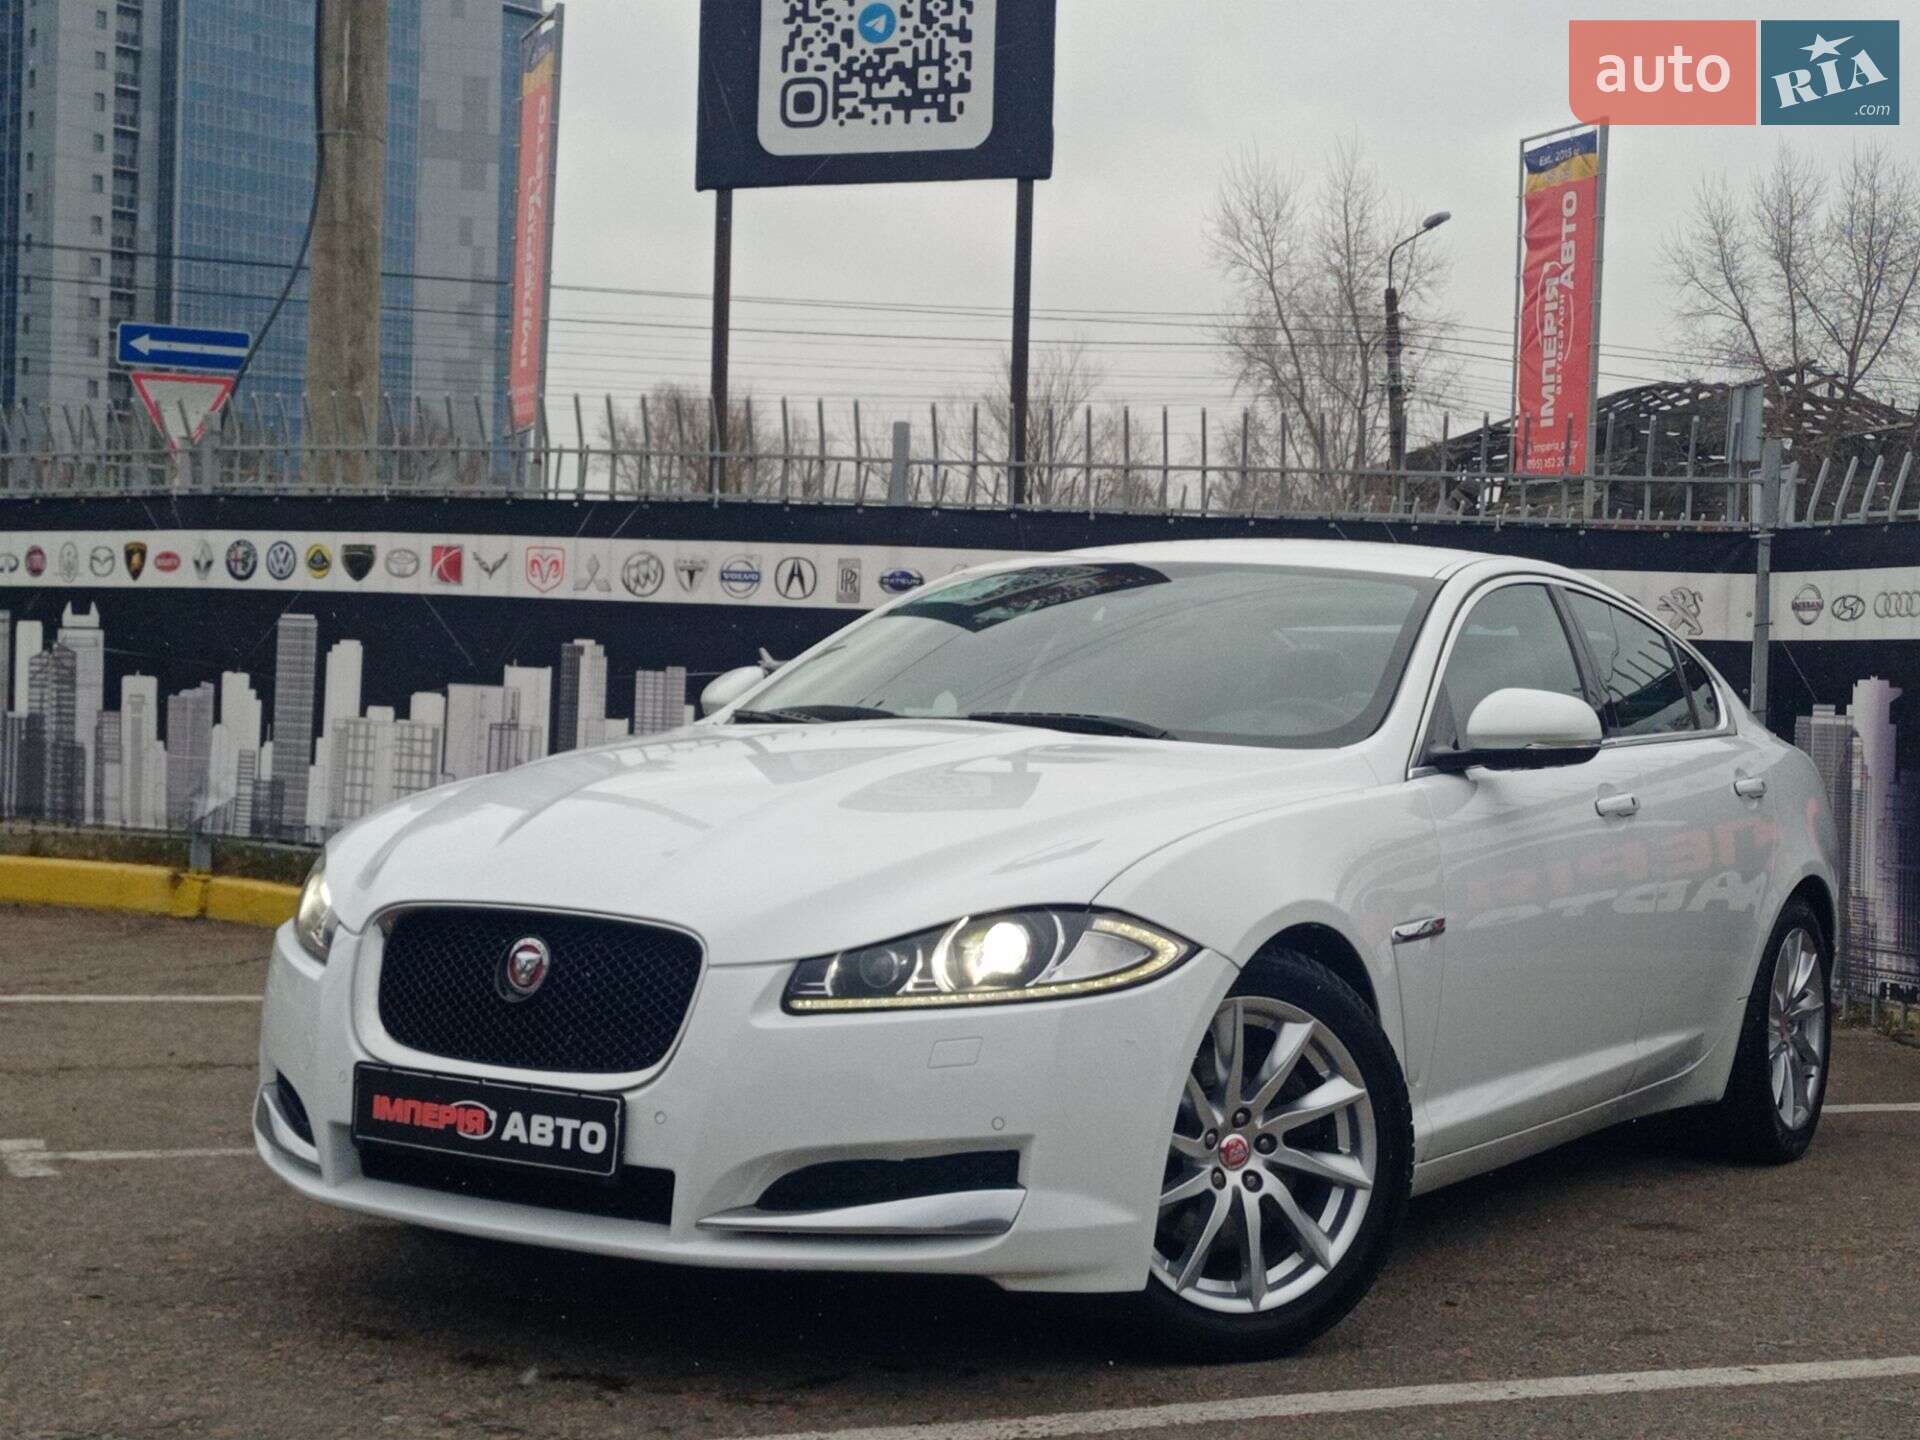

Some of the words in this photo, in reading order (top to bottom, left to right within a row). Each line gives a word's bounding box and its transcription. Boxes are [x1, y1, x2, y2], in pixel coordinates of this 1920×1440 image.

[1559, 190, 1577, 290] АВТО
[1540, 277, 1560, 428] ІМПЕРІЯ
[372, 1094, 486, 1135] ІМПЕРІЯ
[501, 1111, 607, 1154] АВТО
